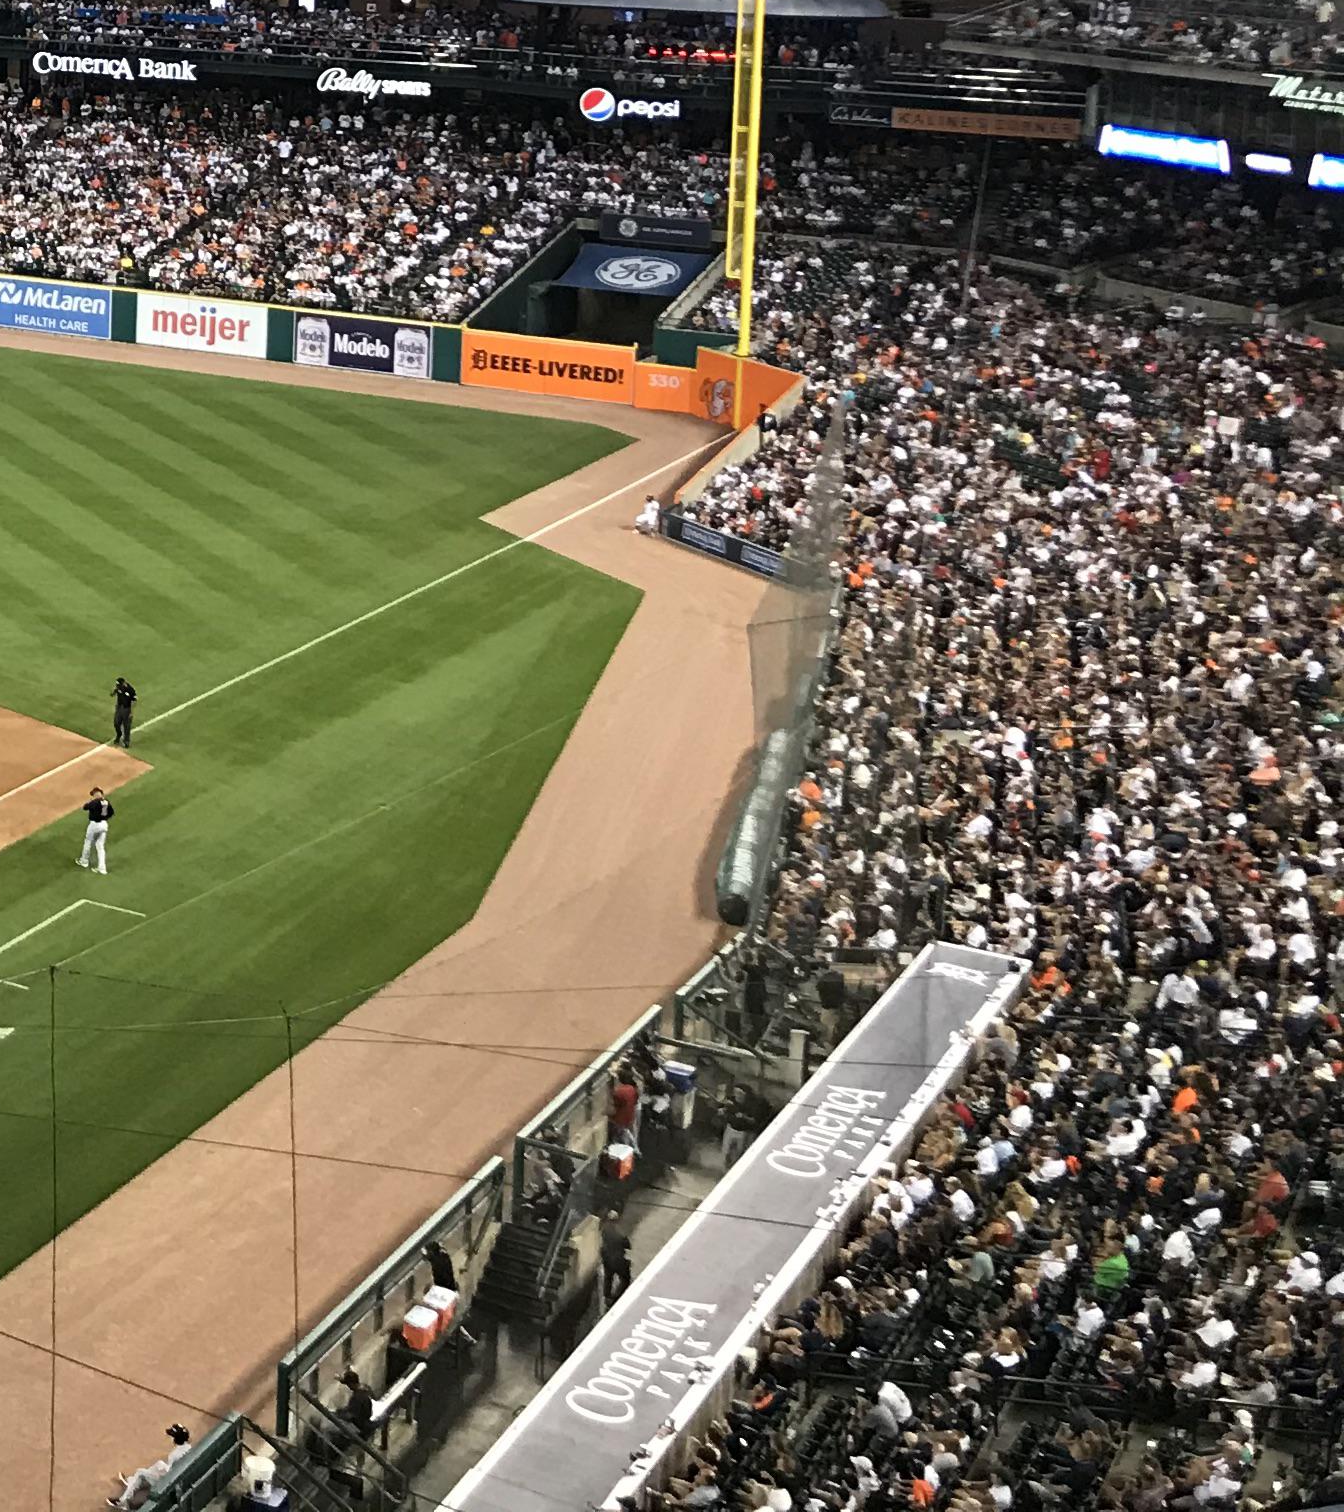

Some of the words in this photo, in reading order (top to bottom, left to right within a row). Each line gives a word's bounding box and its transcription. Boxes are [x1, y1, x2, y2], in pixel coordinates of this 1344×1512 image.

[139, 58, 197, 82] Bank
[316, 67, 383, 100] Bally
[617, 99, 680, 119] pepsi
[23, 285, 107, 315] McLaren
[14, 313, 56, 329] HEALTH
[59, 318, 89, 333] CARE
[151, 306, 251, 346] meijer
[333, 332, 391, 359] Modelo
